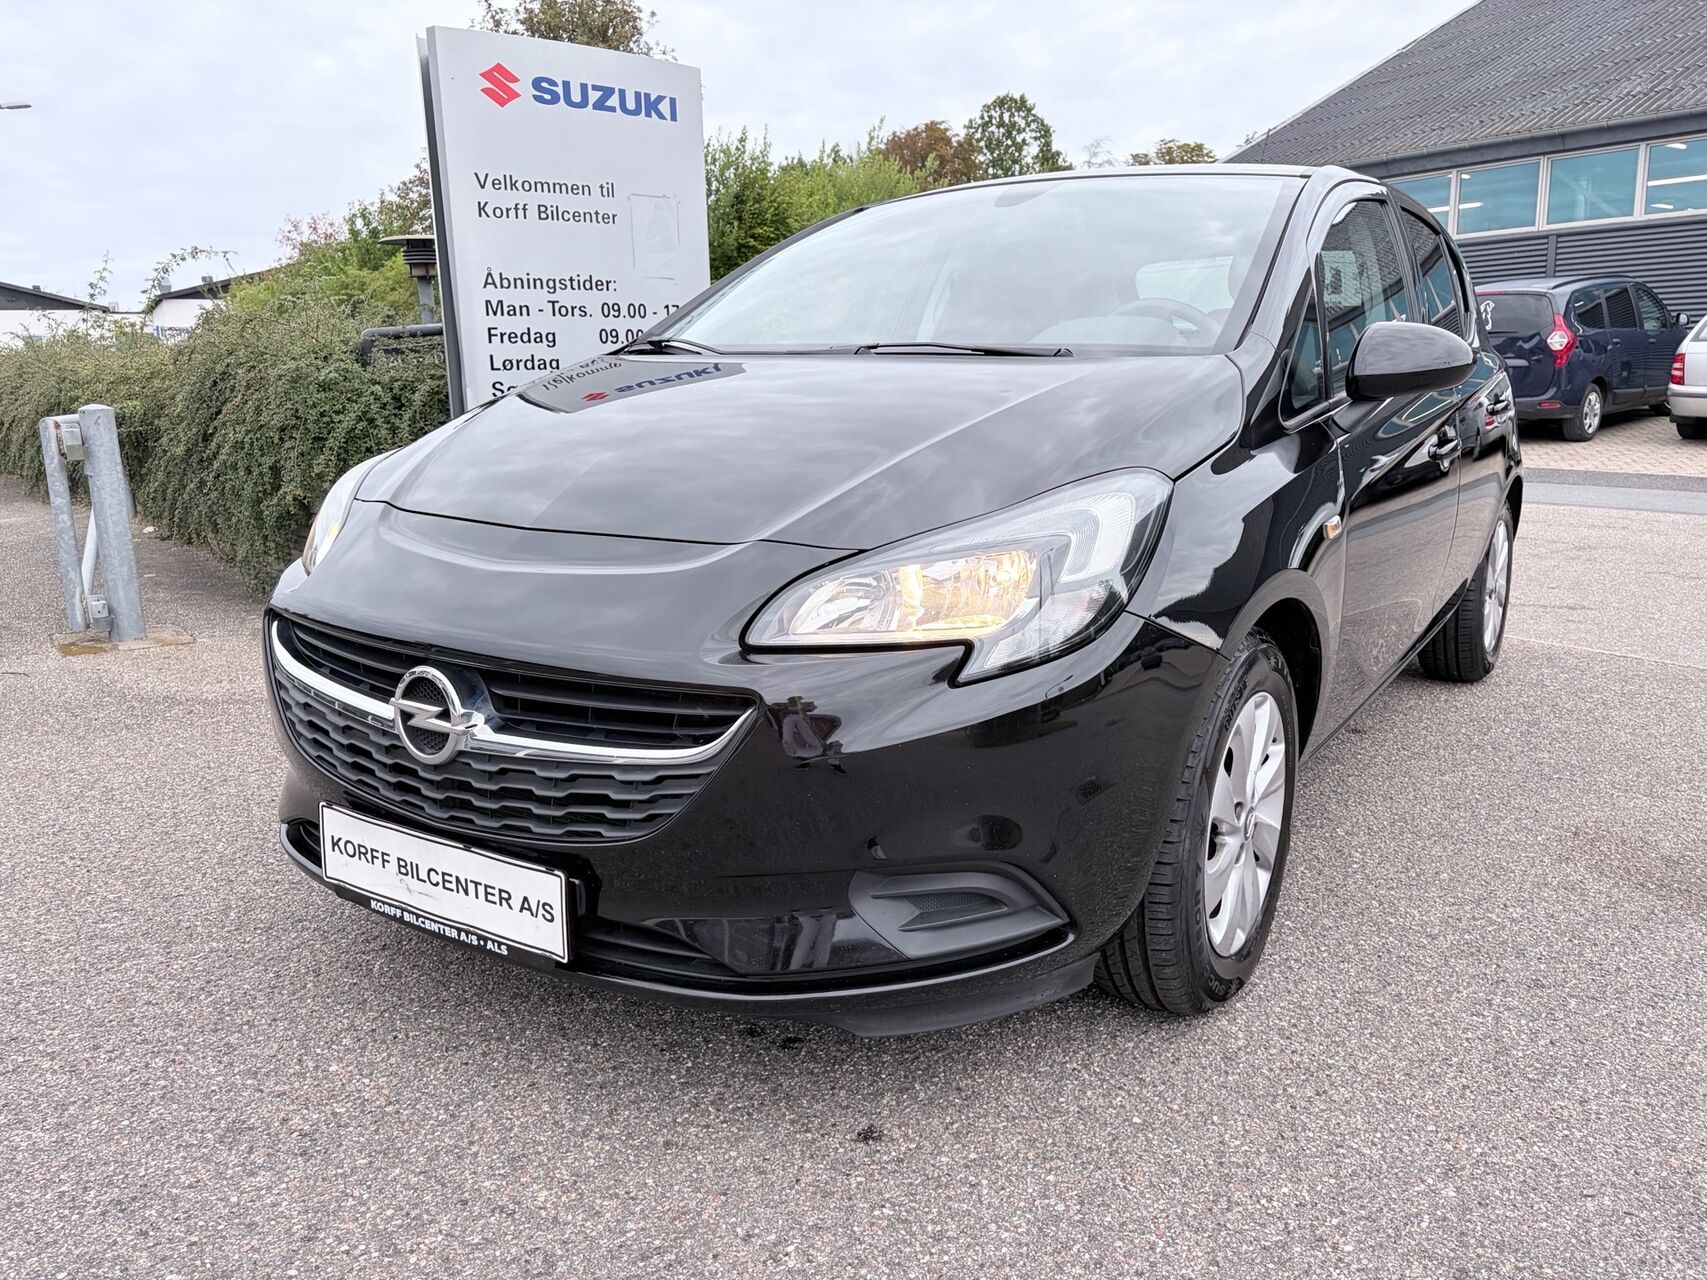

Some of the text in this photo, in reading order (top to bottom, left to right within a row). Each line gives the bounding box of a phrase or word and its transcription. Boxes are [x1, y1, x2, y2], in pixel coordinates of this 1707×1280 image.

[531, 76, 678, 122] SUZUKI
[474, 172, 615, 198] Velkommen til
[477, 201, 618, 225] Korff Bilcenter
[483, 267, 617, 295] Åbningstider:
[485, 300, 531, 317] Man
[547, 300, 593, 318] Tors.
[601, 302, 647, 319] 09.00
[487, 326, 557, 348] Fredag
[331, 835, 556, 924] KORFF BILCENTER A/S
[370, 899, 509, 956] KORFF BILCENTER A/S ALS
